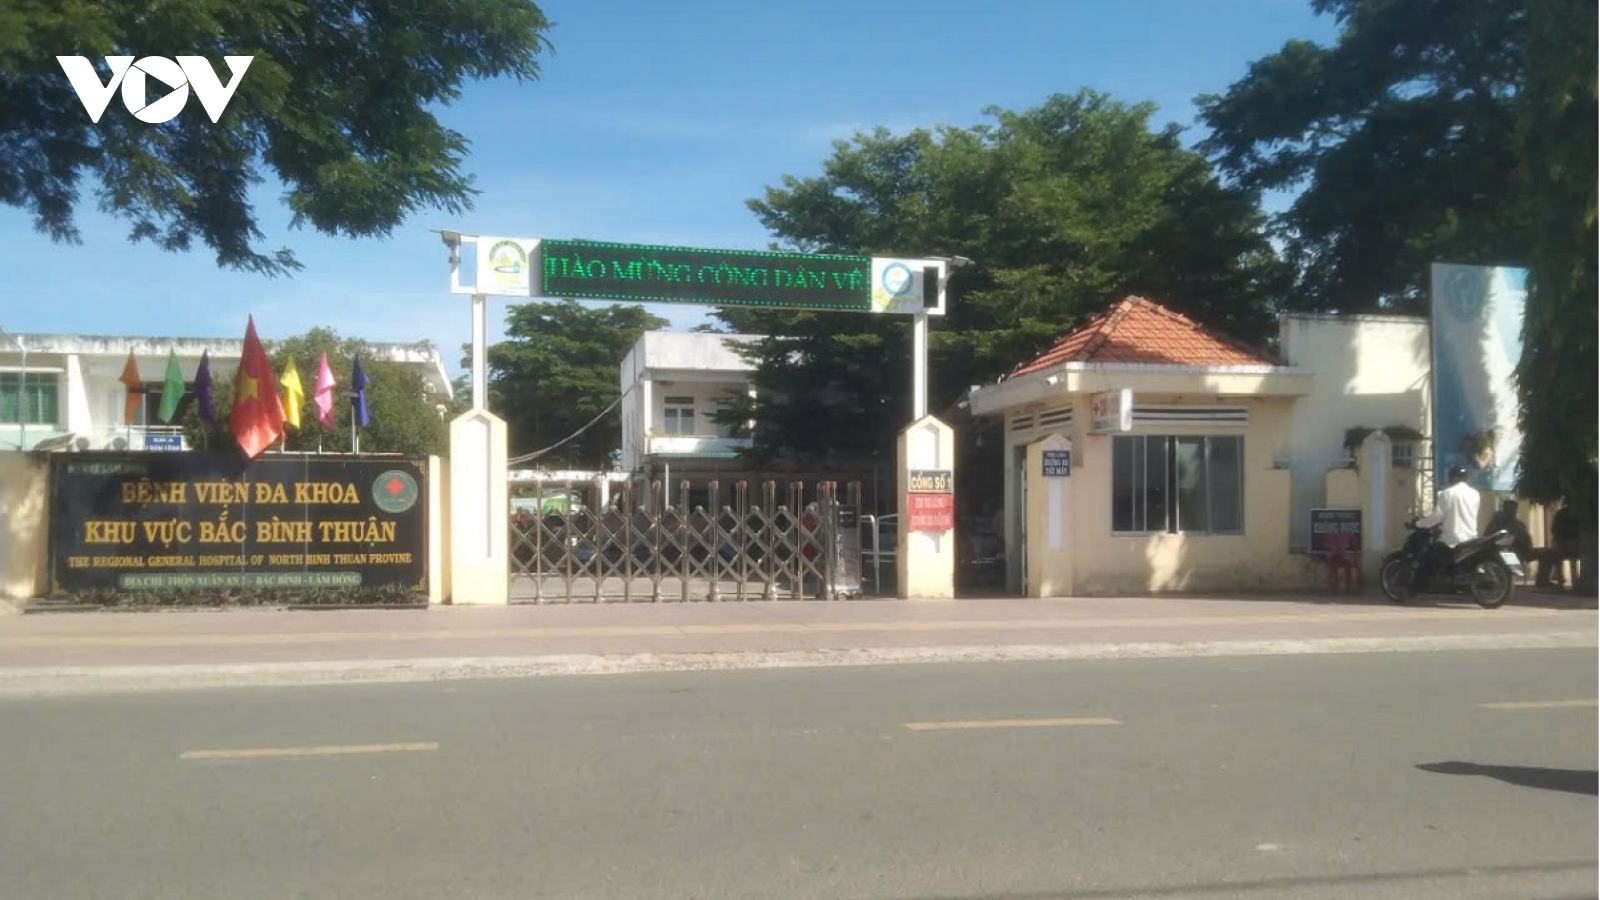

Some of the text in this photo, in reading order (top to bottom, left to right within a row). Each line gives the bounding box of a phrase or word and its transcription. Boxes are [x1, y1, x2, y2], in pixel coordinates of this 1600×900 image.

[697, 260, 768, 287] CÔNG
[774, 264, 826, 290] DÂN
[121, 476, 187, 508] BỆNH
[194, 477, 250, 509] VIỆN
[255, 482, 289, 504] ĐA
[294, 482, 361, 504] KHOA
[910, 470, 934, 490] CỔNG
[935, 472, 947, 490] SỐ
[84, 510, 397, 549] KHU VỰC BẮC BÌNH THUẬN
[68, 552, 412, 568] THE REGIONAL GENERAL HOSPITAL OF NORTH BINH THUAN PROVINE
